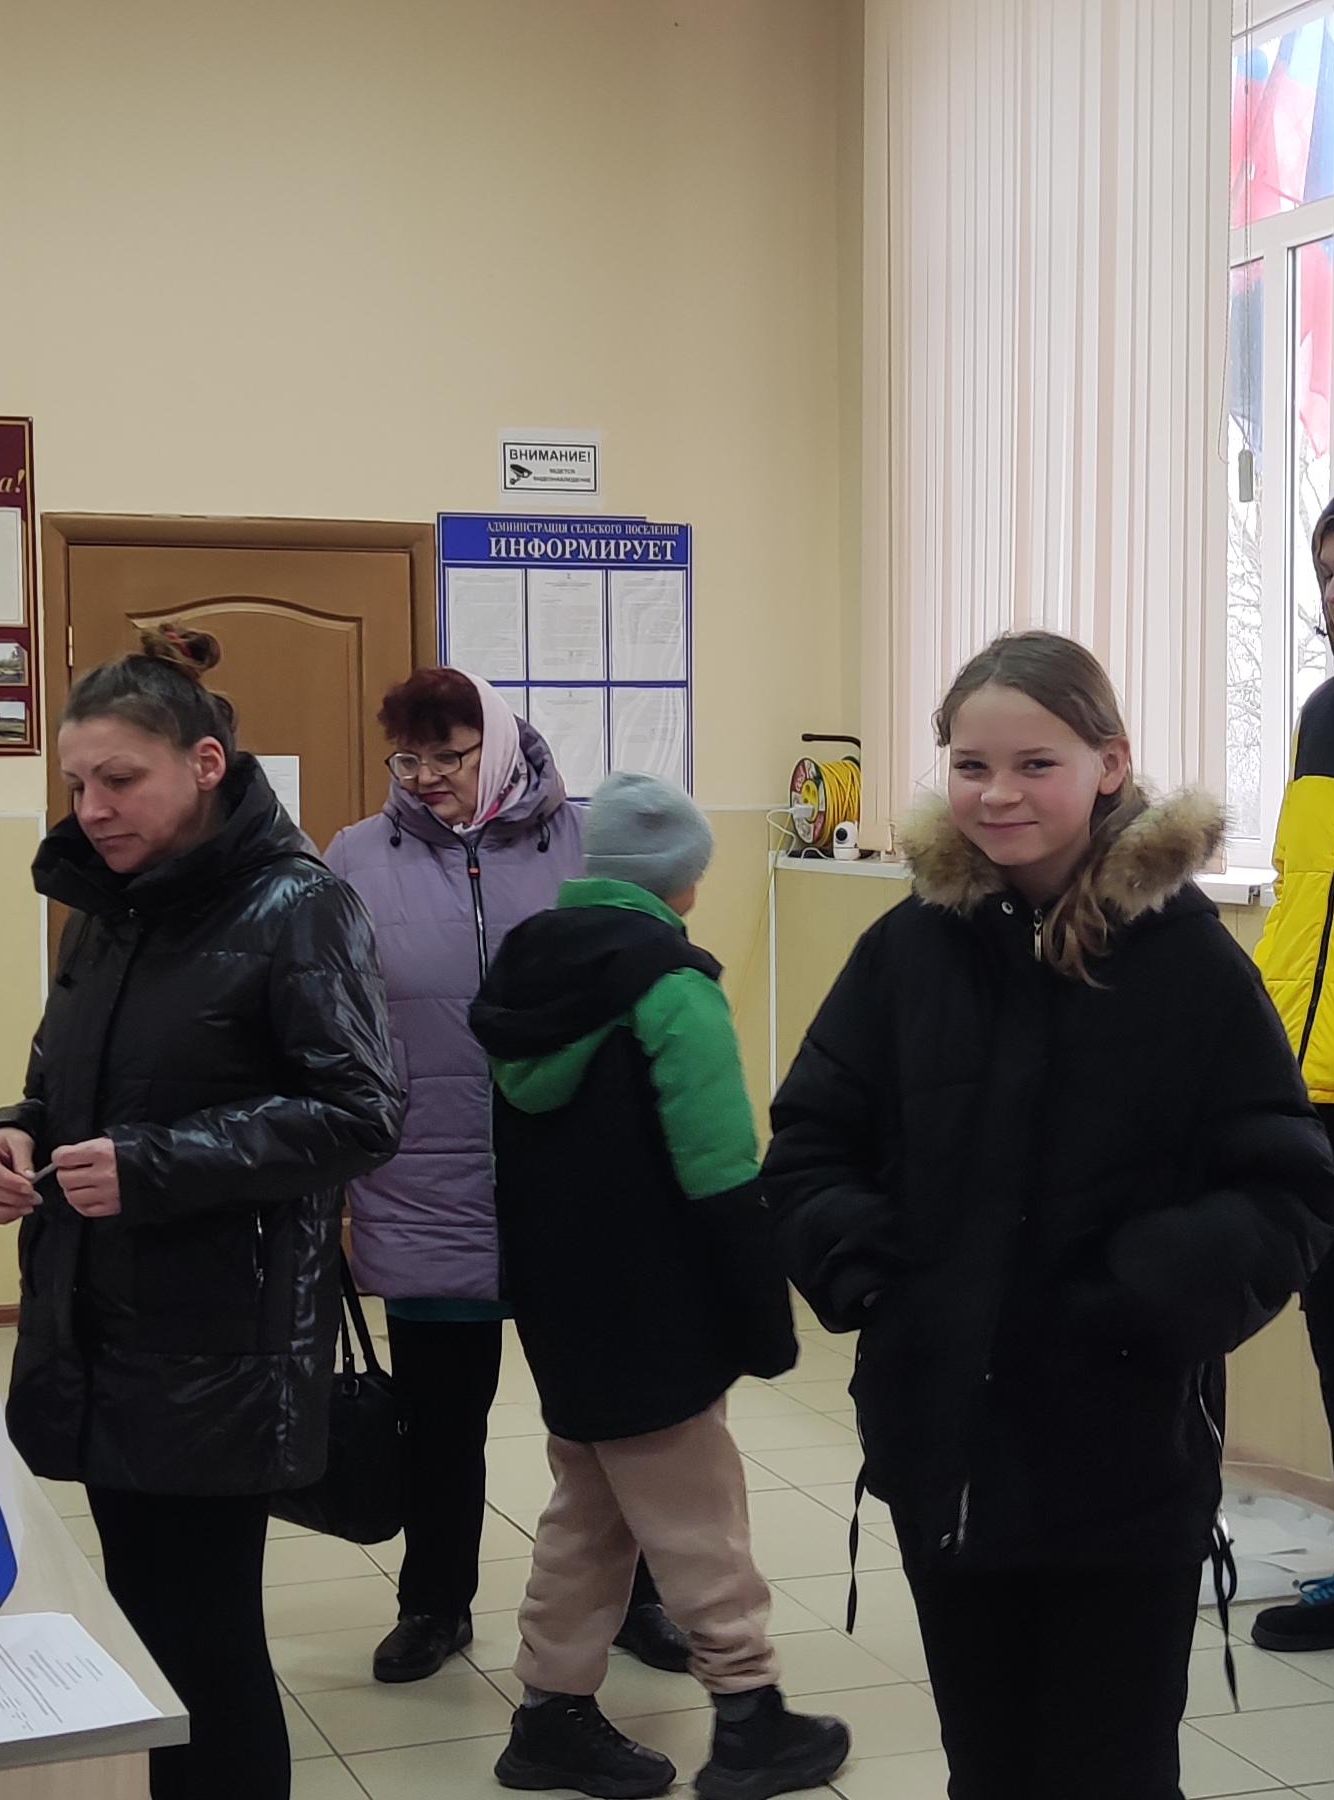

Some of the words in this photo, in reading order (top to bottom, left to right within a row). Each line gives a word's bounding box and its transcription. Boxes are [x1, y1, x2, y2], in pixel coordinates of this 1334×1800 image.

[509, 449, 591, 463] ВНИМАНИЕ!
[486, 521, 567, 534] АДМИНИСТРАЦИЯ
[570, 523, 622, 535] СЕЛЬСКОГО
[625, 525, 680, 536] ПОСЕЛЕНИЯ
[489, 537, 677, 561] ИНФОРМИРУЕТ
